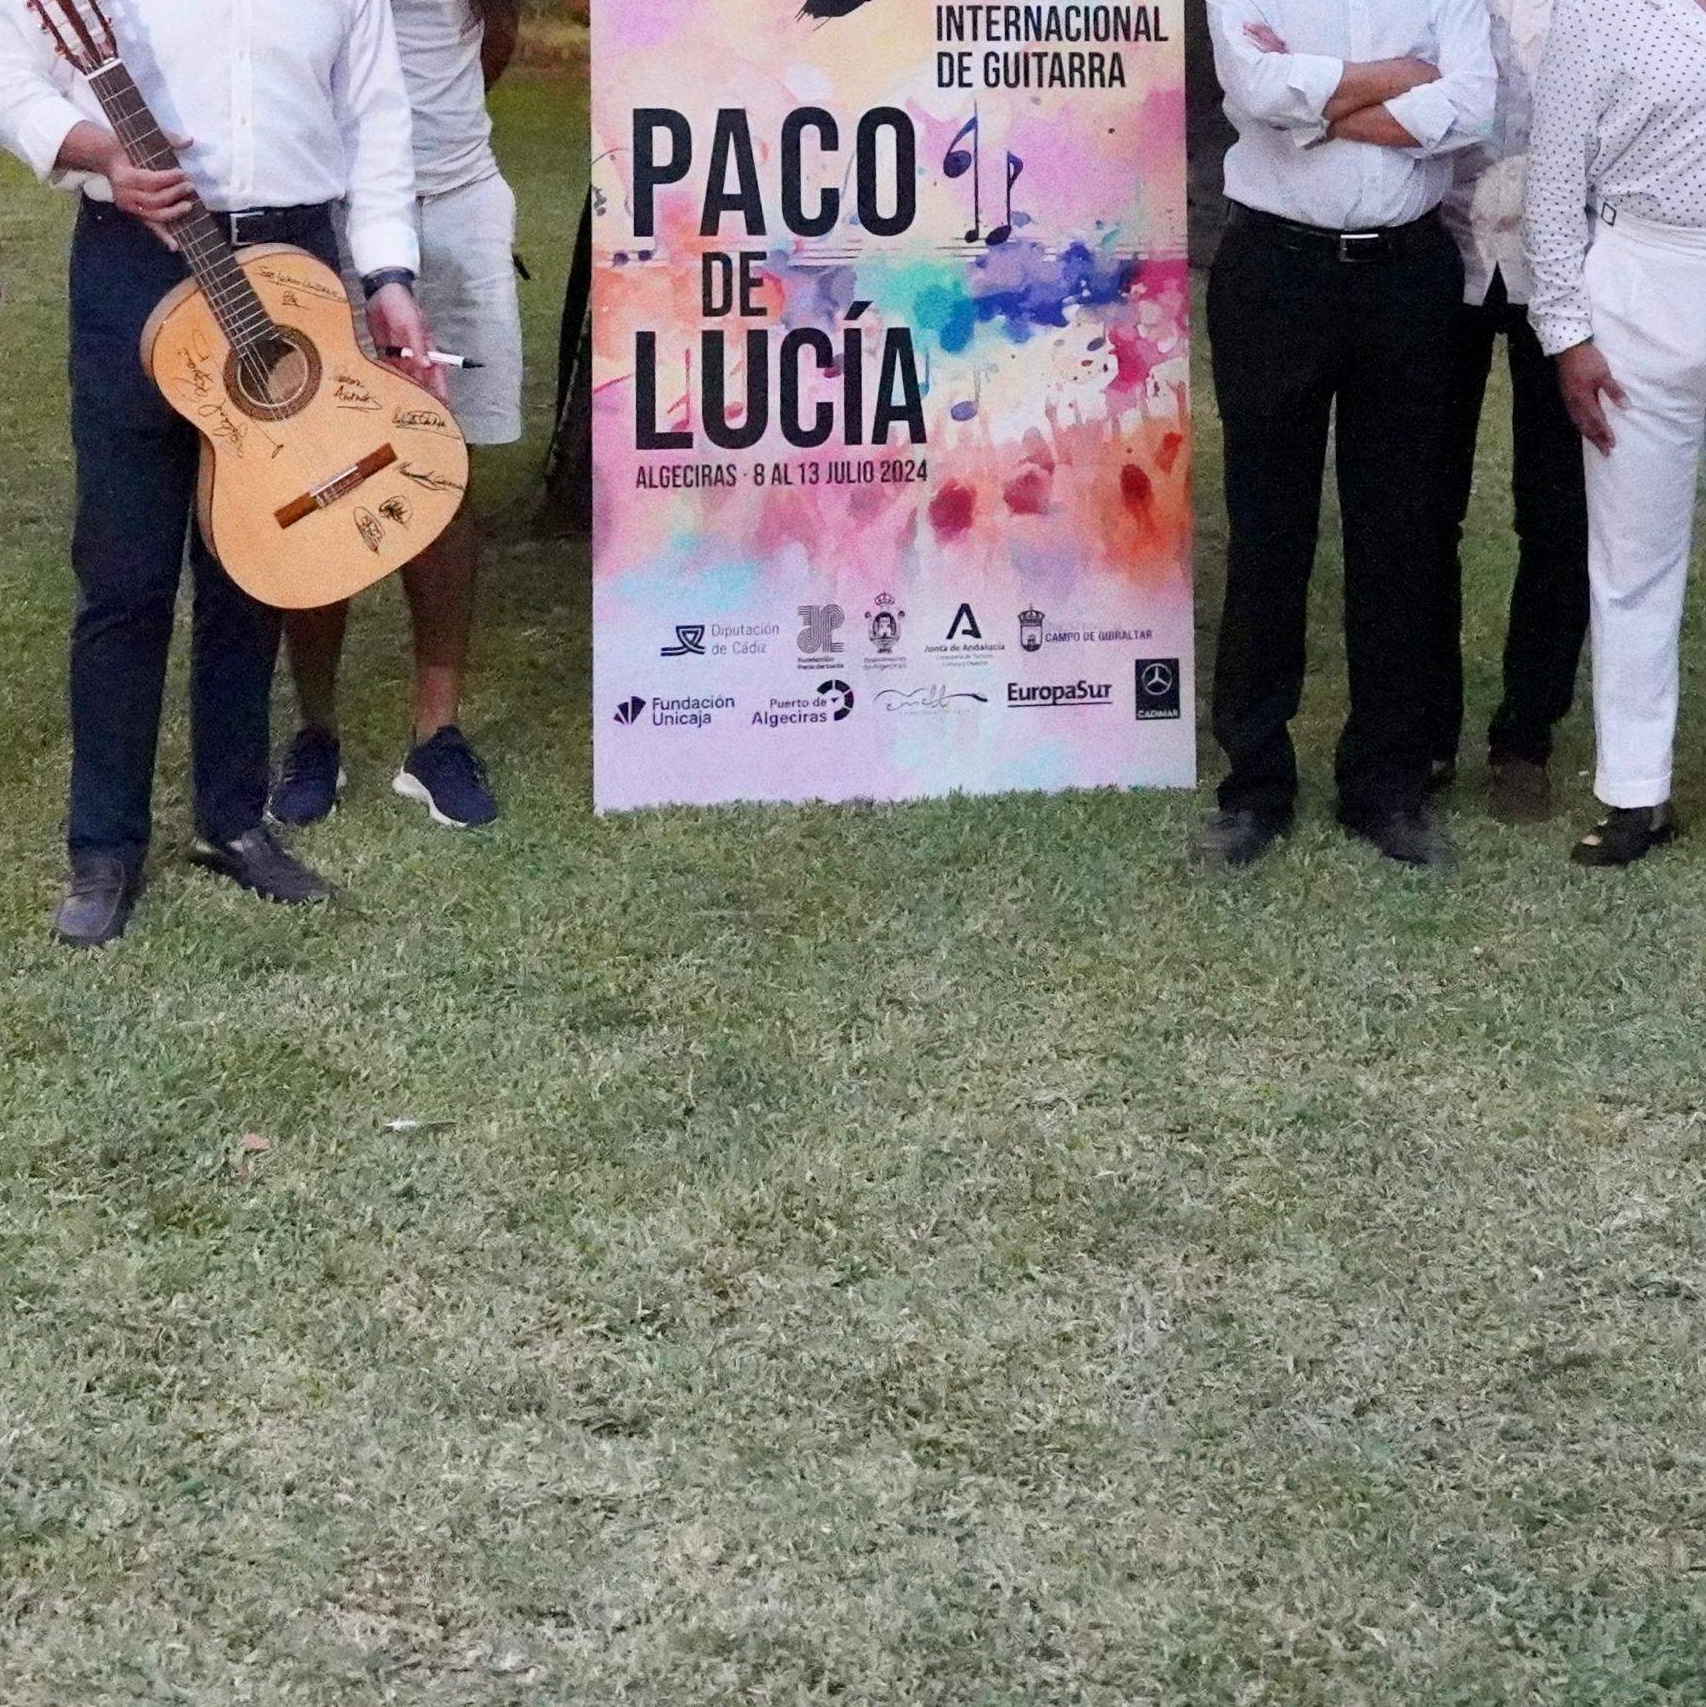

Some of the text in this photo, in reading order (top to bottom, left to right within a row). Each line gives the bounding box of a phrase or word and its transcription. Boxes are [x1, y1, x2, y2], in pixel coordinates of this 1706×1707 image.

[936, 5, 1169, 42] INTERNACIONAL
[937, 51, 1126, 88] DE GUITARRA
[632, 105, 917, 238] PACO
[701, 251, 768, 318] DE
[634, 300, 928, 450] LUCÍA
[635, 459, 929, 489] ALGECIRAS 8 AL 13 JULIO 2024
[711, 622, 780, 638] Diputación
[1083, 631, 1095, 641] DE
[711, 642, 727, 655] de
[652, 695, 735, 711] Fundación
[770, 696, 827, 709] Puerto de
[1007, 680, 1112, 705] EuropaSur
[652, 711, 712, 728] Unicaja
[751, 710, 827, 728] Algeciras
